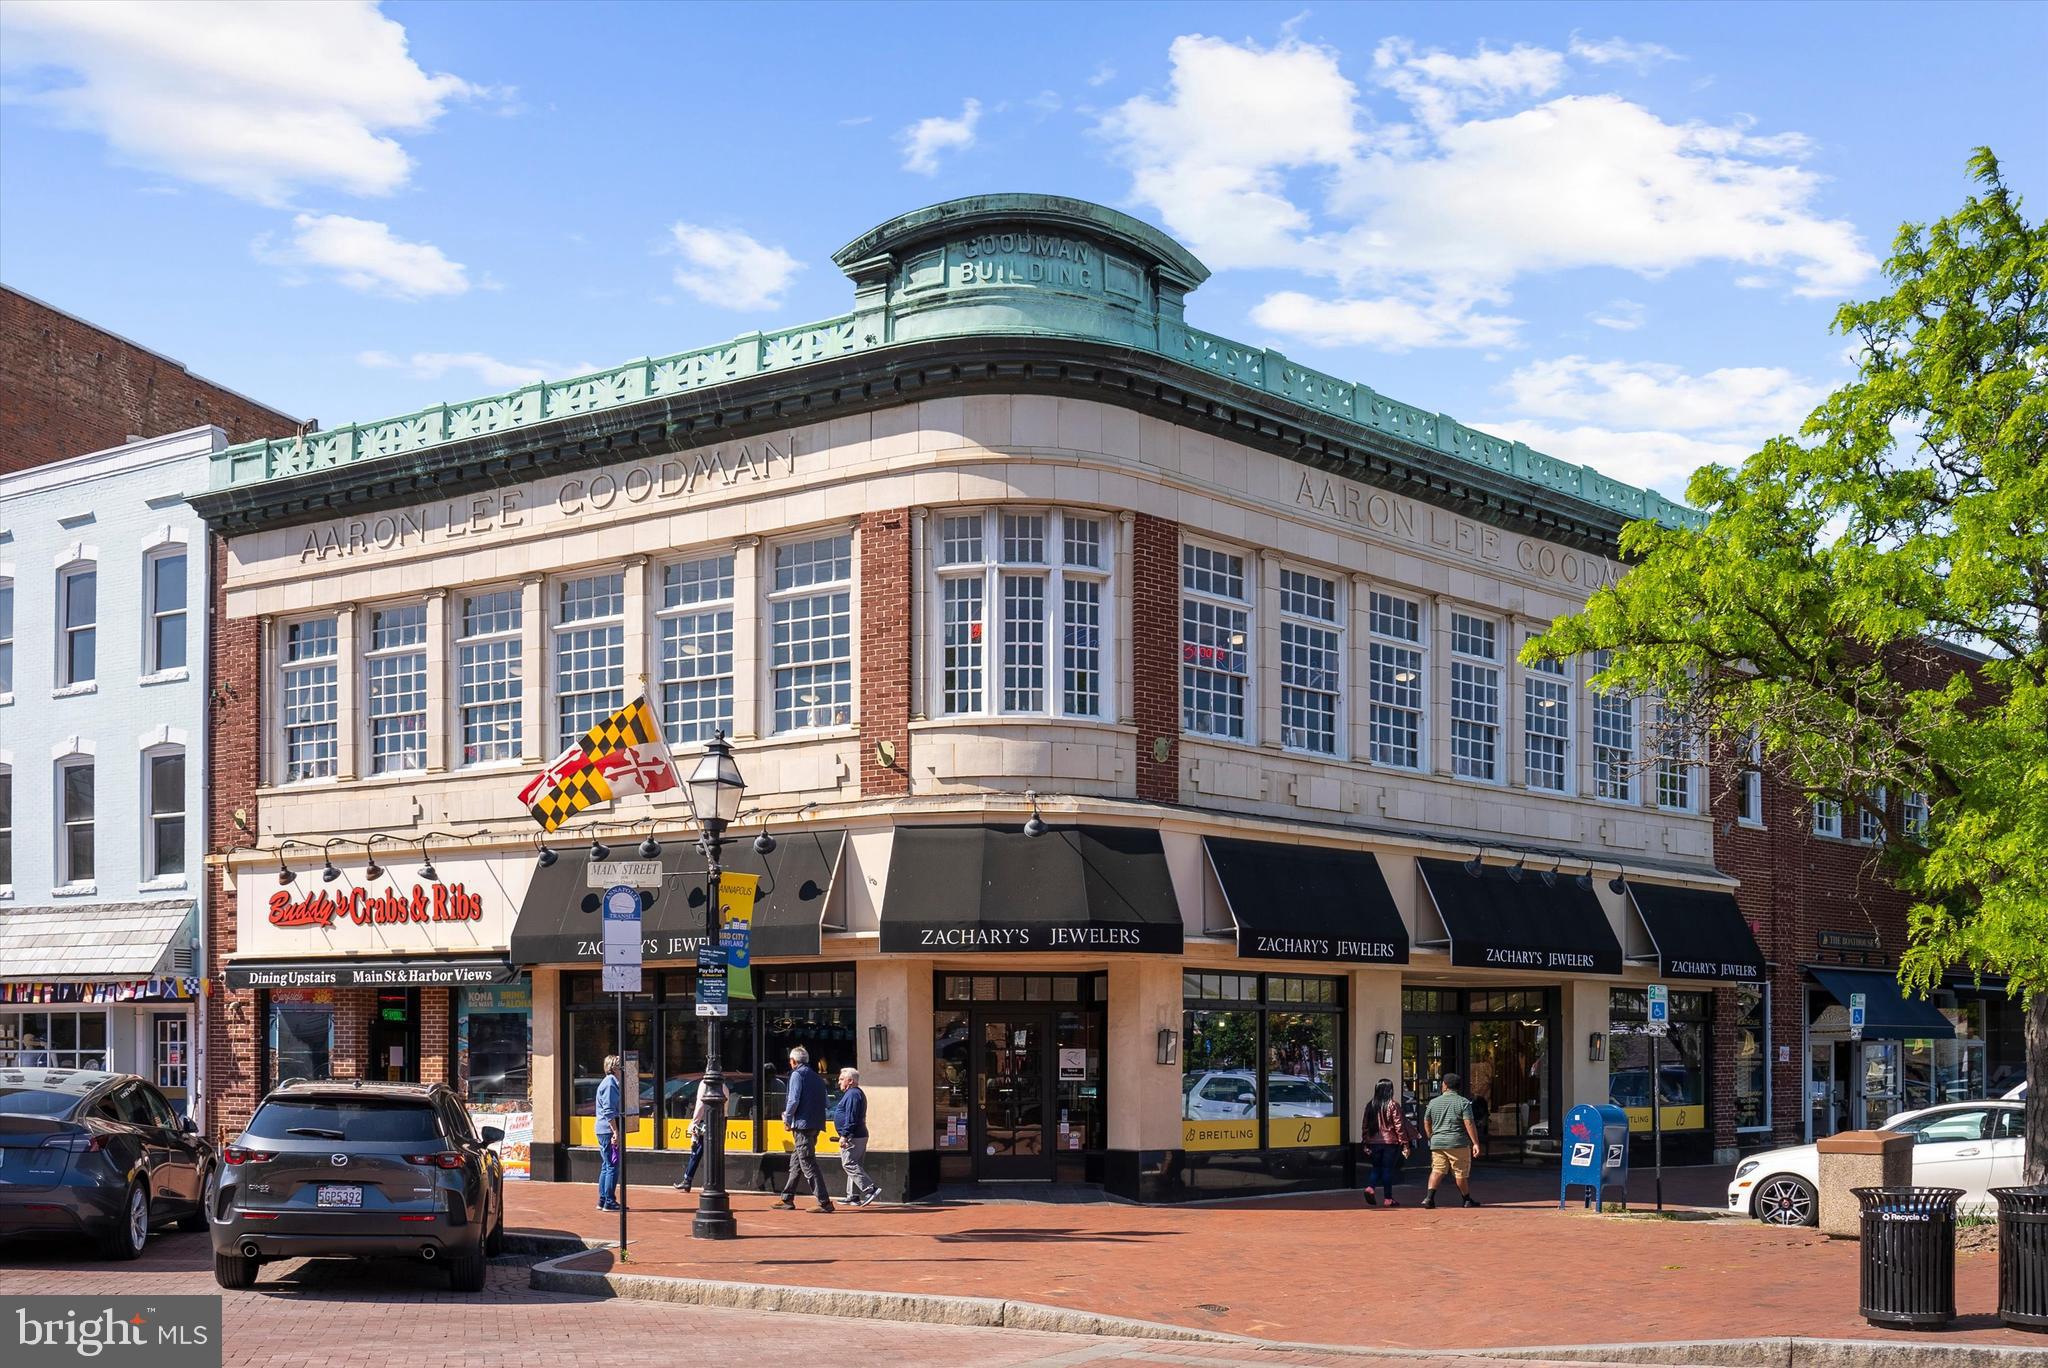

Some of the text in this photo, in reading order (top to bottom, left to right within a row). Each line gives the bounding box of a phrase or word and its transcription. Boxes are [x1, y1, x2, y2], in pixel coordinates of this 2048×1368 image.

[961, 233, 1089, 265] GOODMAN
[960, 262, 1092, 289] BUILDING
[299, 435, 796, 565] AARON LEE GOODMAN
[1296, 471, 1618, 591] AARON LEE GOODM
[592, 863, 659, 876] MAIN STREET
[604, 887, 640, 902] ANNAPOLIS
[268, 882, 482, 928] Buddy's Crabs & Ribs
[921, 928, 1140, 946] ZACHARY'S JEWELERS
[577, 939, 658, 956] ZACY'S
[1257, 936, 1395, 958] ZACHARY'S JEWELERS
[1486, 948, 1594, 967] ZACHARY'S JEWELERS
[249, 968, 493, 985] Dining Upstairs Main St & Harbor Views
[1672, 960, 1757, 977] ZACHARY'S JEWELERS
[469, 991, 493, 1001] KONA
[1199, 1129, 1254, 1140] BREITLING
